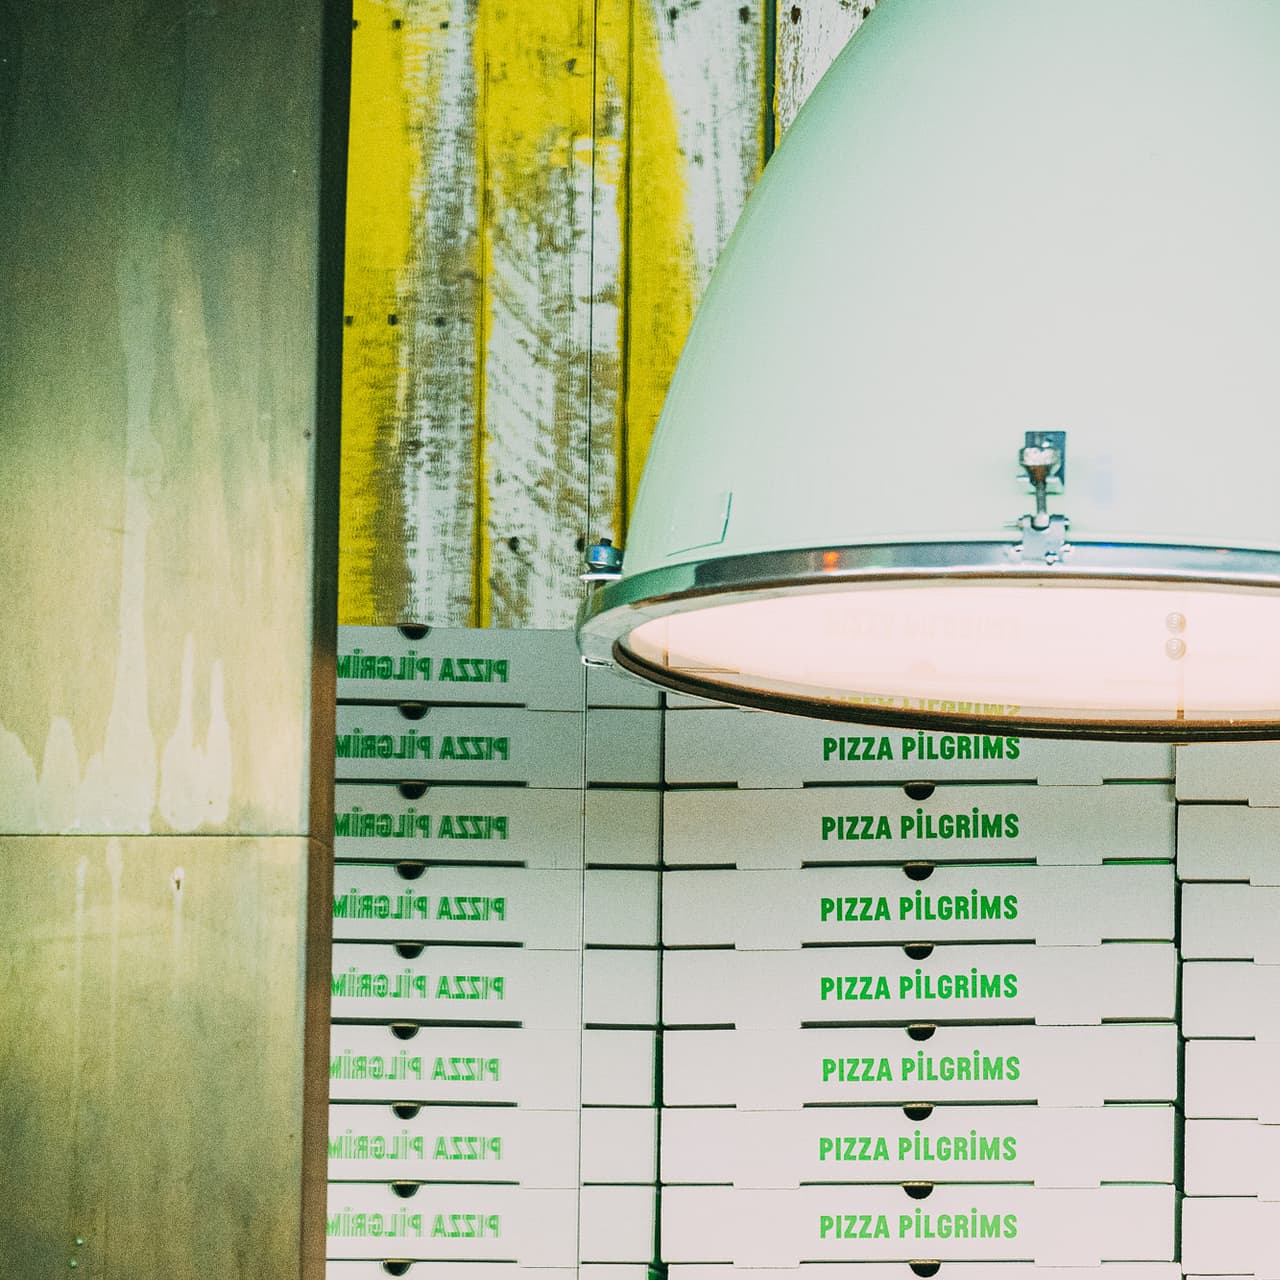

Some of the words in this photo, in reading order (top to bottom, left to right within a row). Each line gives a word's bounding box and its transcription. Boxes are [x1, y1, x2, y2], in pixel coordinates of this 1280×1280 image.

[822, 736, 893, 762] PIZZA
[822, 816, 892, 841] PIZZA
[820, 896, 891, 922] PIZZA
[822, 1058, 893, 1082] PIZZA
[819, 1137, 889, 1161] PIZZA
[820, 1215, 890, 1239] PIZZA
